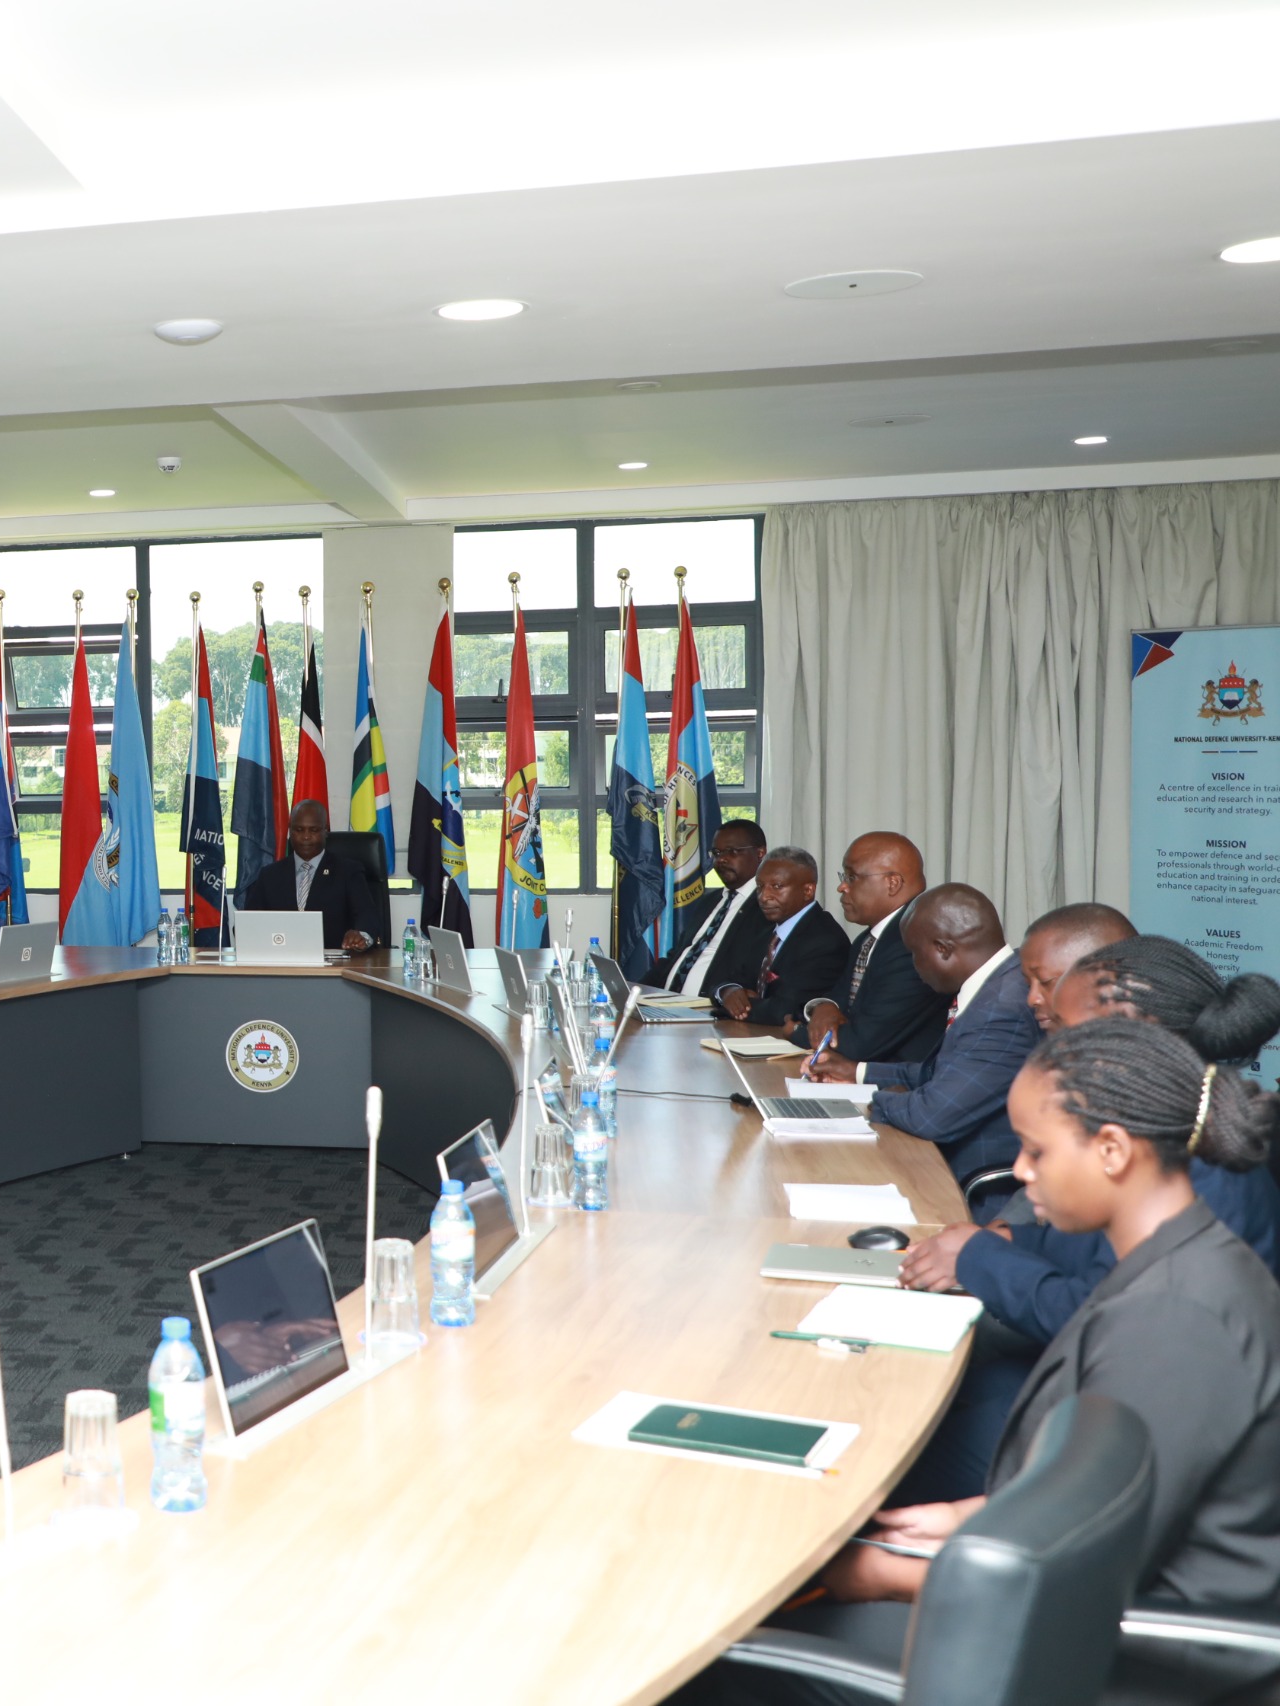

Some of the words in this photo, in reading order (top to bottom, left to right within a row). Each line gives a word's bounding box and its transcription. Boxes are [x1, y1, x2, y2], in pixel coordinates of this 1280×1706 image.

[1211, 772, 1245, 781] VISION
[1159, 784, 1166, 792] A
[1167, 784, 1194, 792] centre
[1197, 783, 1206, 792] of
[1207, 784, 1251, 792] excellence
[1253, 784, 1261, 792] in
[1156, 794, 1199, 802] education
[1200, 794, 1216, 803] and
[1218, 794, 1254, 803] research
[1256, 795, 1264, 803] in
[1184, 805, 1216, 815] security
[1217, 805, 1233, 814] and
[1235, 806, 1273, 816] strategy.
[1206, 839, 1247, 849] MISSION
[1156, 848, 1167, 857] To
[1168, 850, 1209, 859] empower
[1210, 850, 1243, 860] defence
[1245, 852, 1262, 860] and
[1157, 860, 1211, 869] professionals
[1213, 861, 1246, 872] through
[1156, 870, 1198, 880] education
[1199, 872, 1216, 881] and
[1217, 873, 1249, 884] training
[1251, 874, 1259, 883] in
[1156, 881, 1193, 891] enhance
[1194, 883, 1227, 893] capacity
[1229, 884, 1237, 893] in
[1191, 894, 1223, 904] national
[1225, 896, 1258, 906] interest.
[1205, 928, 1241, 939] VALUES
[1184, 938, 1224, 949] Academic
[1226, 941, 1263, 951] Freedom
[1206, 951, 1240, 963] Honesty
[231, 1031, 246, 1061] NATIONAL
[245, 1024, 274, 1033] DEFENCE
[276, 1028, 295, 1063] UNIVERSITY
